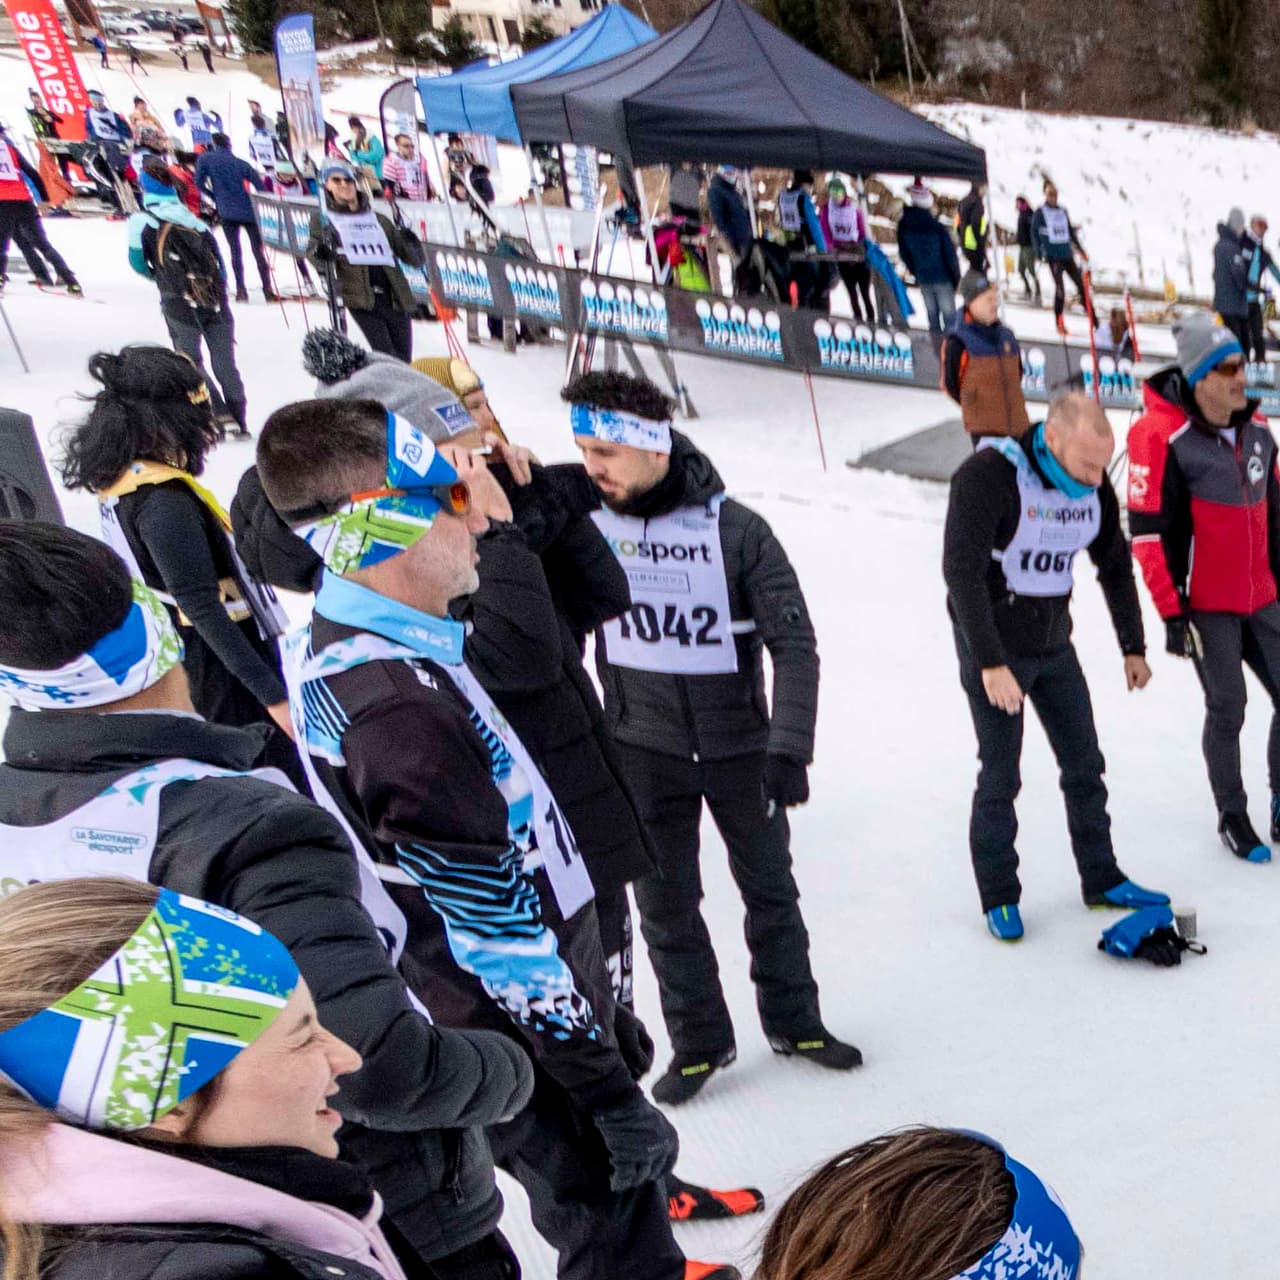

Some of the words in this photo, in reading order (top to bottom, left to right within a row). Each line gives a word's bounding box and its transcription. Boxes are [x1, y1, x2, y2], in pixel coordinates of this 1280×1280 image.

[16, 10, 75, 116] savoie
[351, 243, 386, 256] 1111
[586, 308, 668, 333] EXPERIENCE
[704, 330, 783, 355] EXPERIENCE
[820, 348, 913, 371] EXPERIENCE
[1027, 503, 1094, 525] ekosport
[606, 532, 712, 564] kosport
